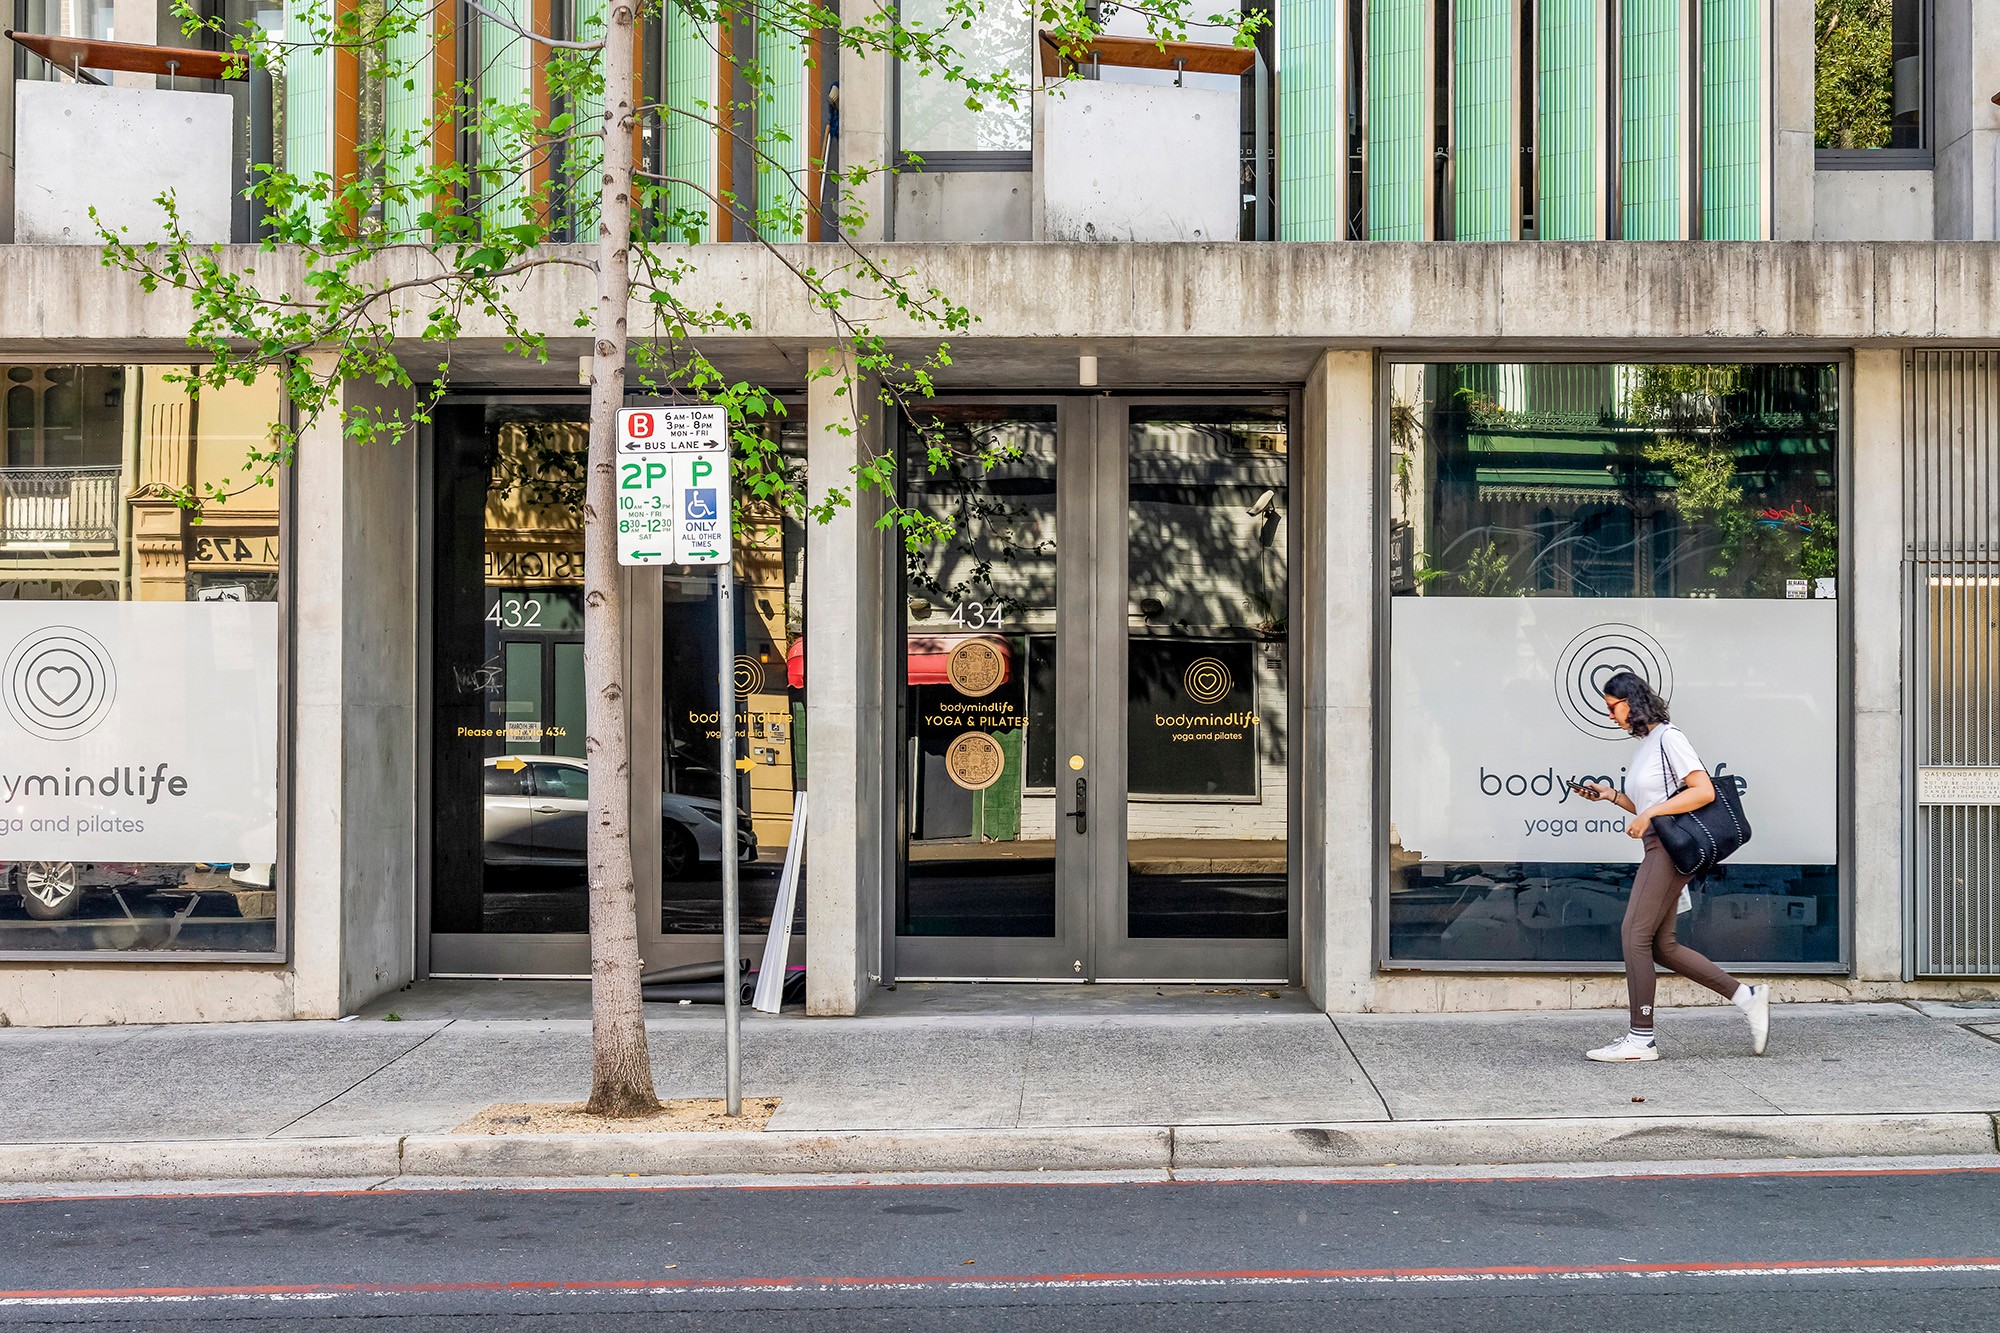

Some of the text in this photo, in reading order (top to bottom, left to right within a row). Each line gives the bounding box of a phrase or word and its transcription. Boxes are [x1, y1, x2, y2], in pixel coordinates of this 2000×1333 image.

[634, 415, 648, 436] B
[645, 441, 699, 450] BUS LANE
[622, 463, 667, 489] 2P
[692, 461, 712, 486] P
[686, 522, 717, 531] ONLY
[485, 600, 542, 627] 432
[948, 602, 1004, 629] 434
[940, 702, 1014, 715] bodymindlife
[925, 716, 1030, 726] YOGA & PILATES
[1156, 711, 1260, 729] bodymindlife
[458, 727, 492, 737] Please
[496, 728, 525, 737] enter
[528, 727, 543, 737] via
[546, 727, 567, 737] 434
[1172, 732, 1242, 741] yoga and pilates
[30, 816, 70, 833] and
[77, 815, 144, 836] pilates
[1524, 816, 1626, 837] yoga and
